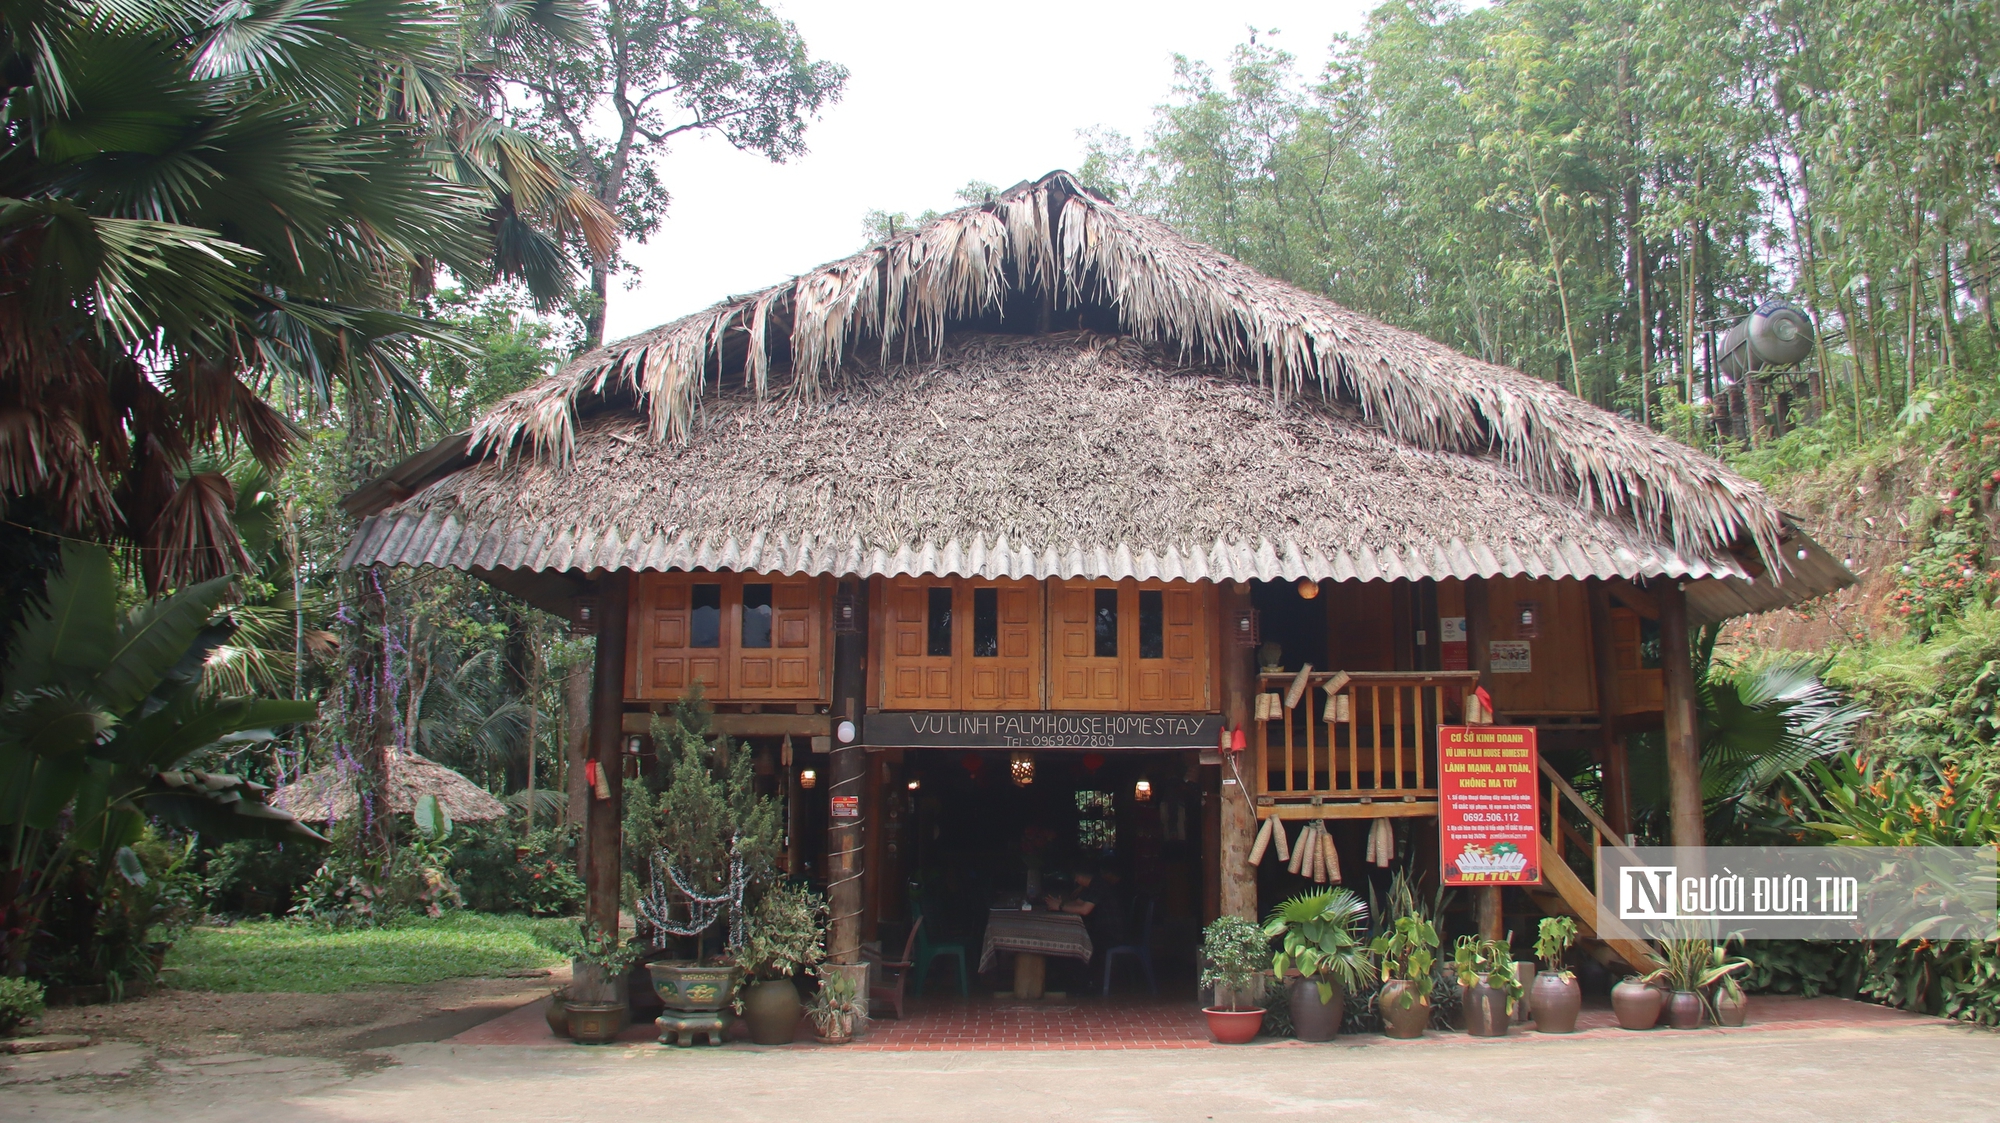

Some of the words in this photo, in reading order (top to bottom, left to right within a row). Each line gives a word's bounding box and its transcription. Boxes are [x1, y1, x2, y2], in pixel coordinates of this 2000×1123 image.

[1031, 735, 1115, 747] 0969207809
[1450, 733, 1461, 743] CƠ
[1476, 734, 1495, 743] KINH
[1497, 734, 1524, 743] DOANH
[1444, 762, 1466, 773] LÀNH
[1467, 763, 1494, 775] MẠNH,
[1495, 763, 1507, 773] AN
[1508, 762, 1531, 774] TOÀN,
[1459, 777, 1487, 788] KHÔNG
[1488, 779, 1501, 788] MA
[1463, 813, 1519, 822] 0692.506.112
[1461, 872, 1485, 881] MA
